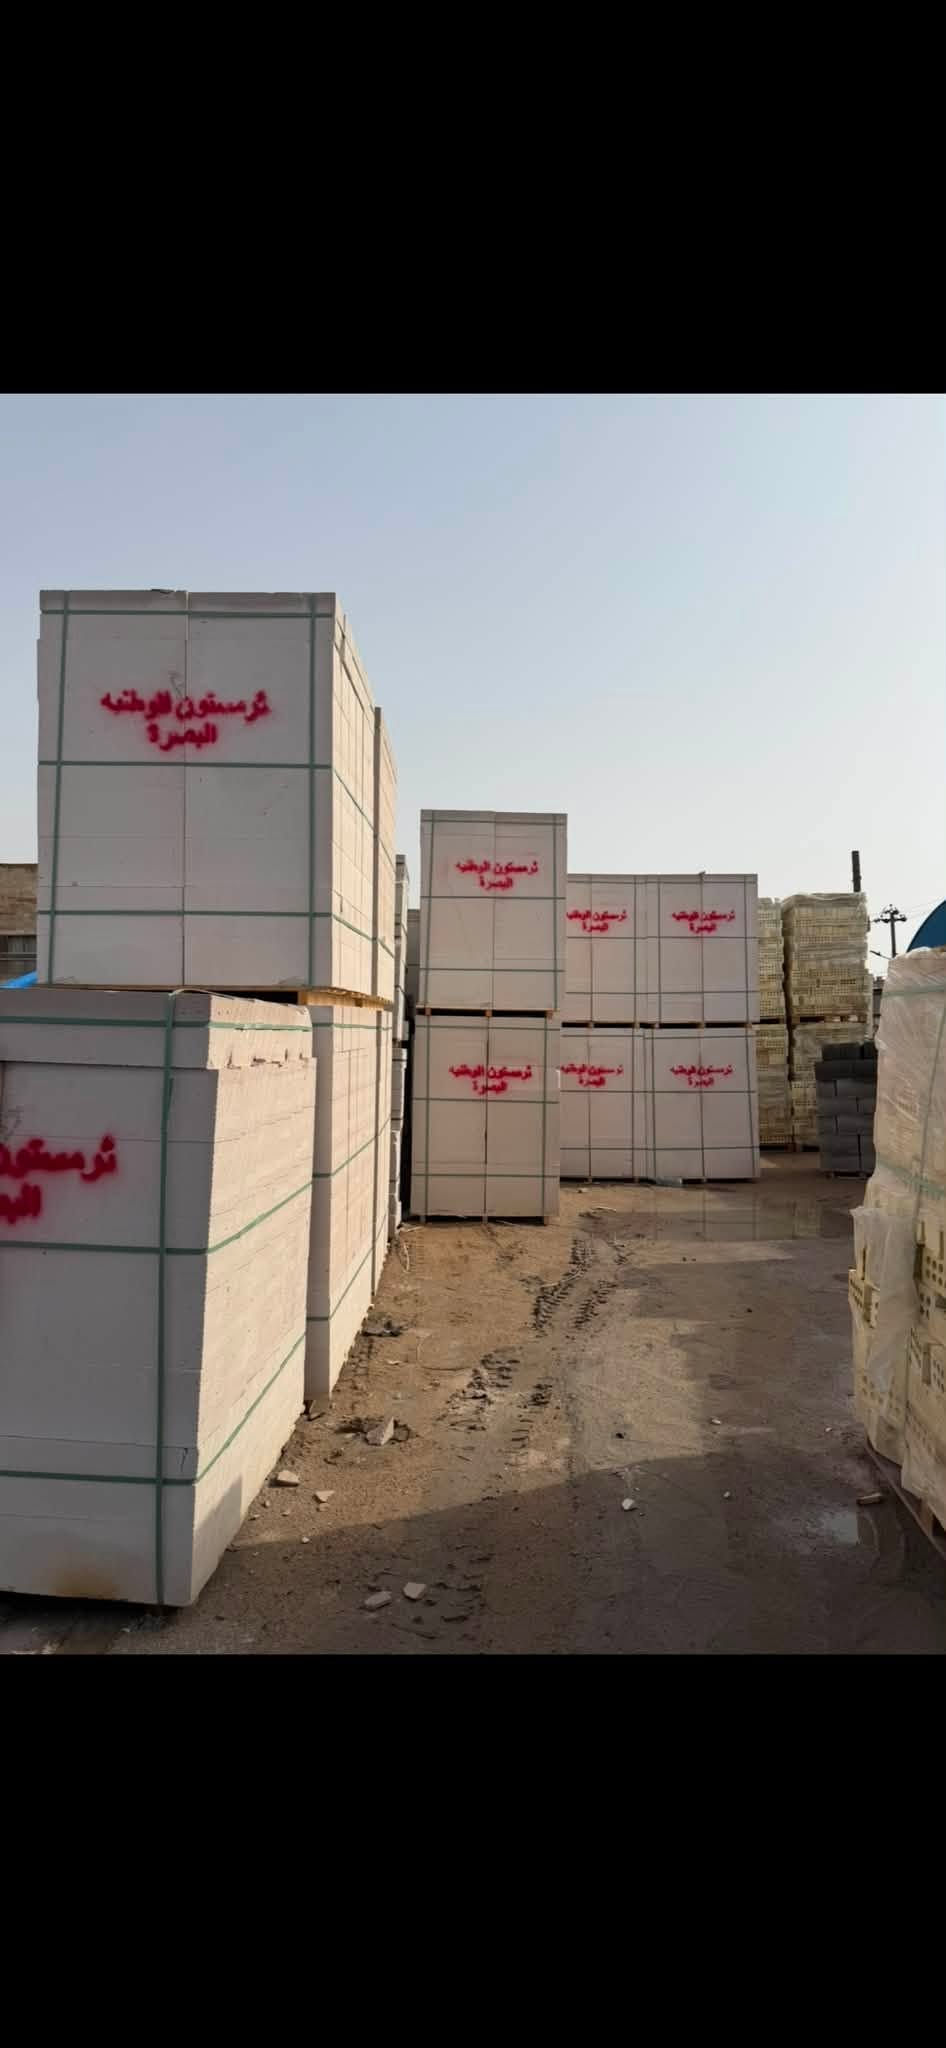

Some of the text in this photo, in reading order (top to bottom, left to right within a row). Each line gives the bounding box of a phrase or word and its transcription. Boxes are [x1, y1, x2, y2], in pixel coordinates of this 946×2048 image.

[146, 721, 219, 752] البصرة
[479, 874, 514, 892] البصرة
[471, 1080, 508, 1096] البصرة
